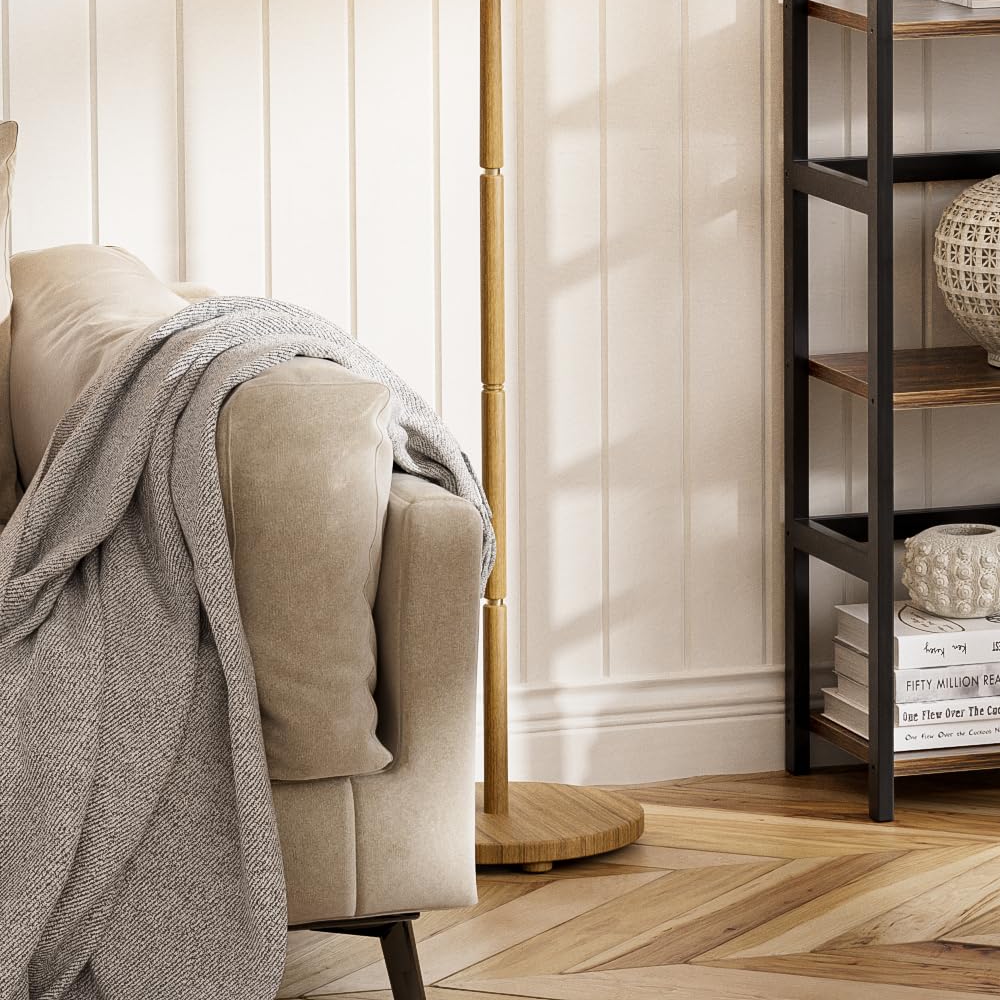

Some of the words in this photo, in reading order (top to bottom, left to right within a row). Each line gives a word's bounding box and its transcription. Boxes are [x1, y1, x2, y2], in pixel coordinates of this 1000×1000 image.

[923, 642, 945, 657] Kesey
[952, 643, 967, 655] Ken
[906, 679, 932, 692] FIFTY
[936, 675, 979, 689] MILLION
[902, 711, 919, 722] One
[921, 709, 943, 721] Flew
[945, 707, 965, 719] Over
[968, 706, 985, 717] The
[937, 731, 954, 739] Over
